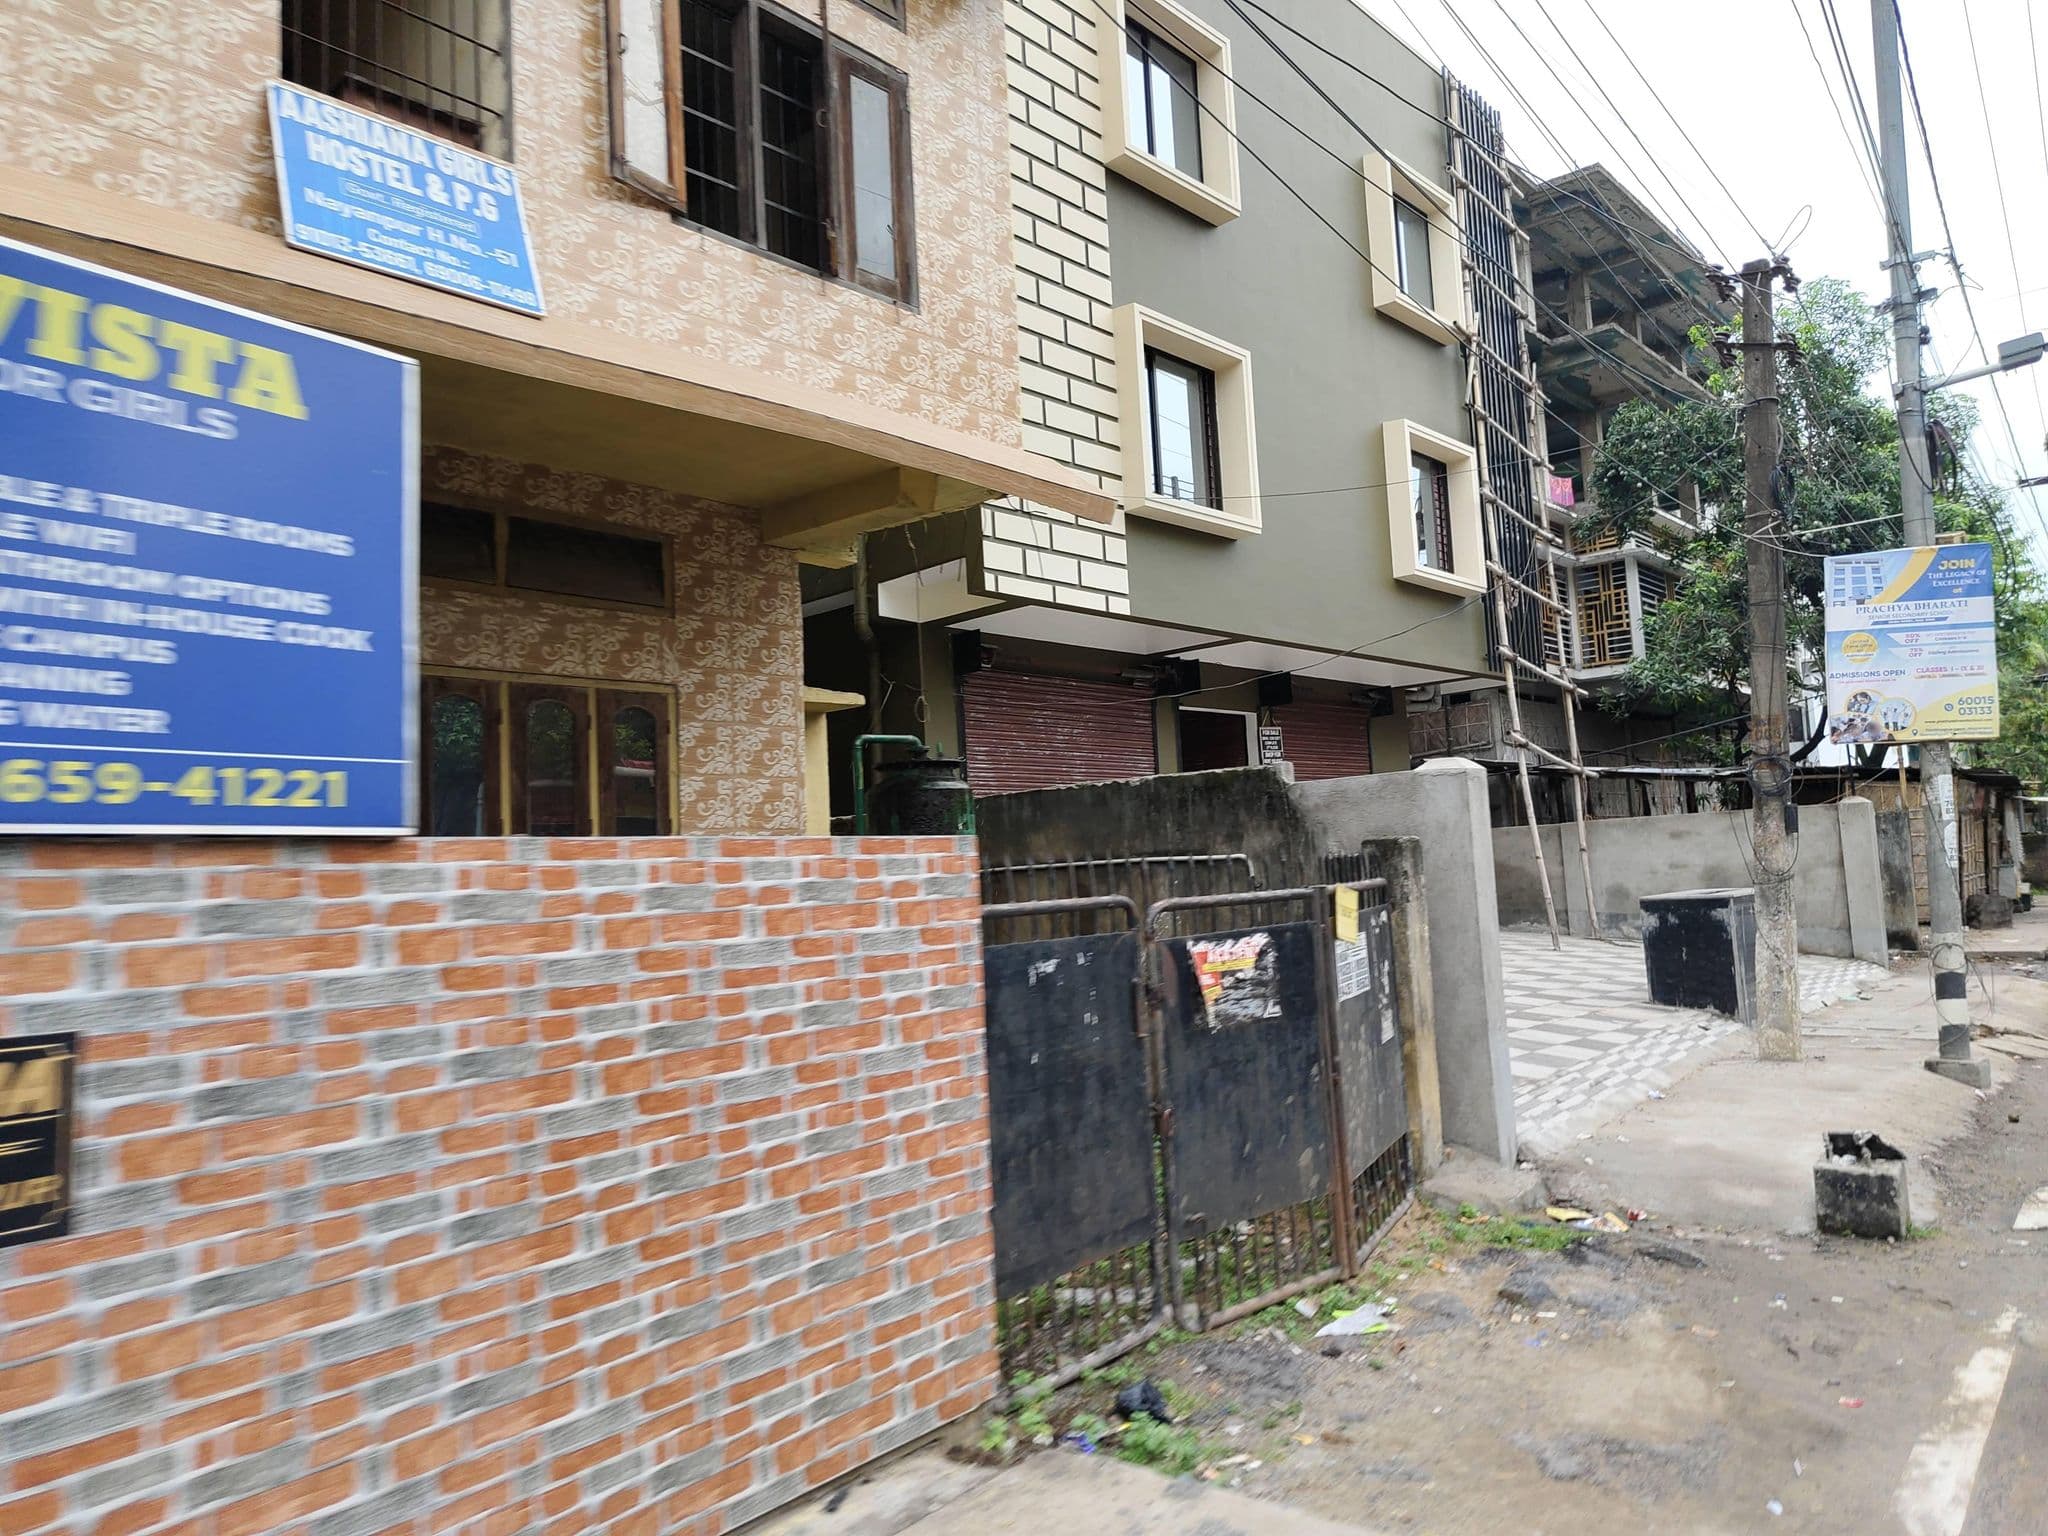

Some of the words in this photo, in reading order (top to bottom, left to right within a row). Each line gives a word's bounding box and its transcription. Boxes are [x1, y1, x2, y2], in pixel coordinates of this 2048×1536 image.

[279, 87, 433, 169] AASHIANA
[435, 145, 514, 196] GIRLS
[305, 130, 424, 197] HOSTEL
[425, 172, 452, 207] &
[366, 227, 435, 259] Contact
[0, 274, 310, 421] VISTA
[67, 378, 239, 440] GIRLS
[38, 517, 137, 556] WIFI
[97, 491, 230, 537] TRIPLE
[231, 514, 355, 557] ROOMS
[1938, 559, 1975, 570] JOIN
[1945, 570, 1975, 578] LEGACY
[176, 574, 332, 616] OPTIONS
[1932, 578, 1981, 587] EXCELLENCE
[1855, 602, 1911, 615] PRACHYA
[1914, 599, 1969, 611] BHARATI
[98, 597, 276, 641] IN-HOUSE
[277, 621, 374, 652] COOK
[4, 624, 179, 664] CAMPUS
[1829, 670, 1881, 680] ADMISSIONS
[1883, 669, 1906, 677] OPEN
[1916, 666, 1947, 674] CLASSES
[1958, 696, 1995, 705] 60015
[1958, 706, 1992, 716] 03133
[20, 701, 172, 734] WATER
